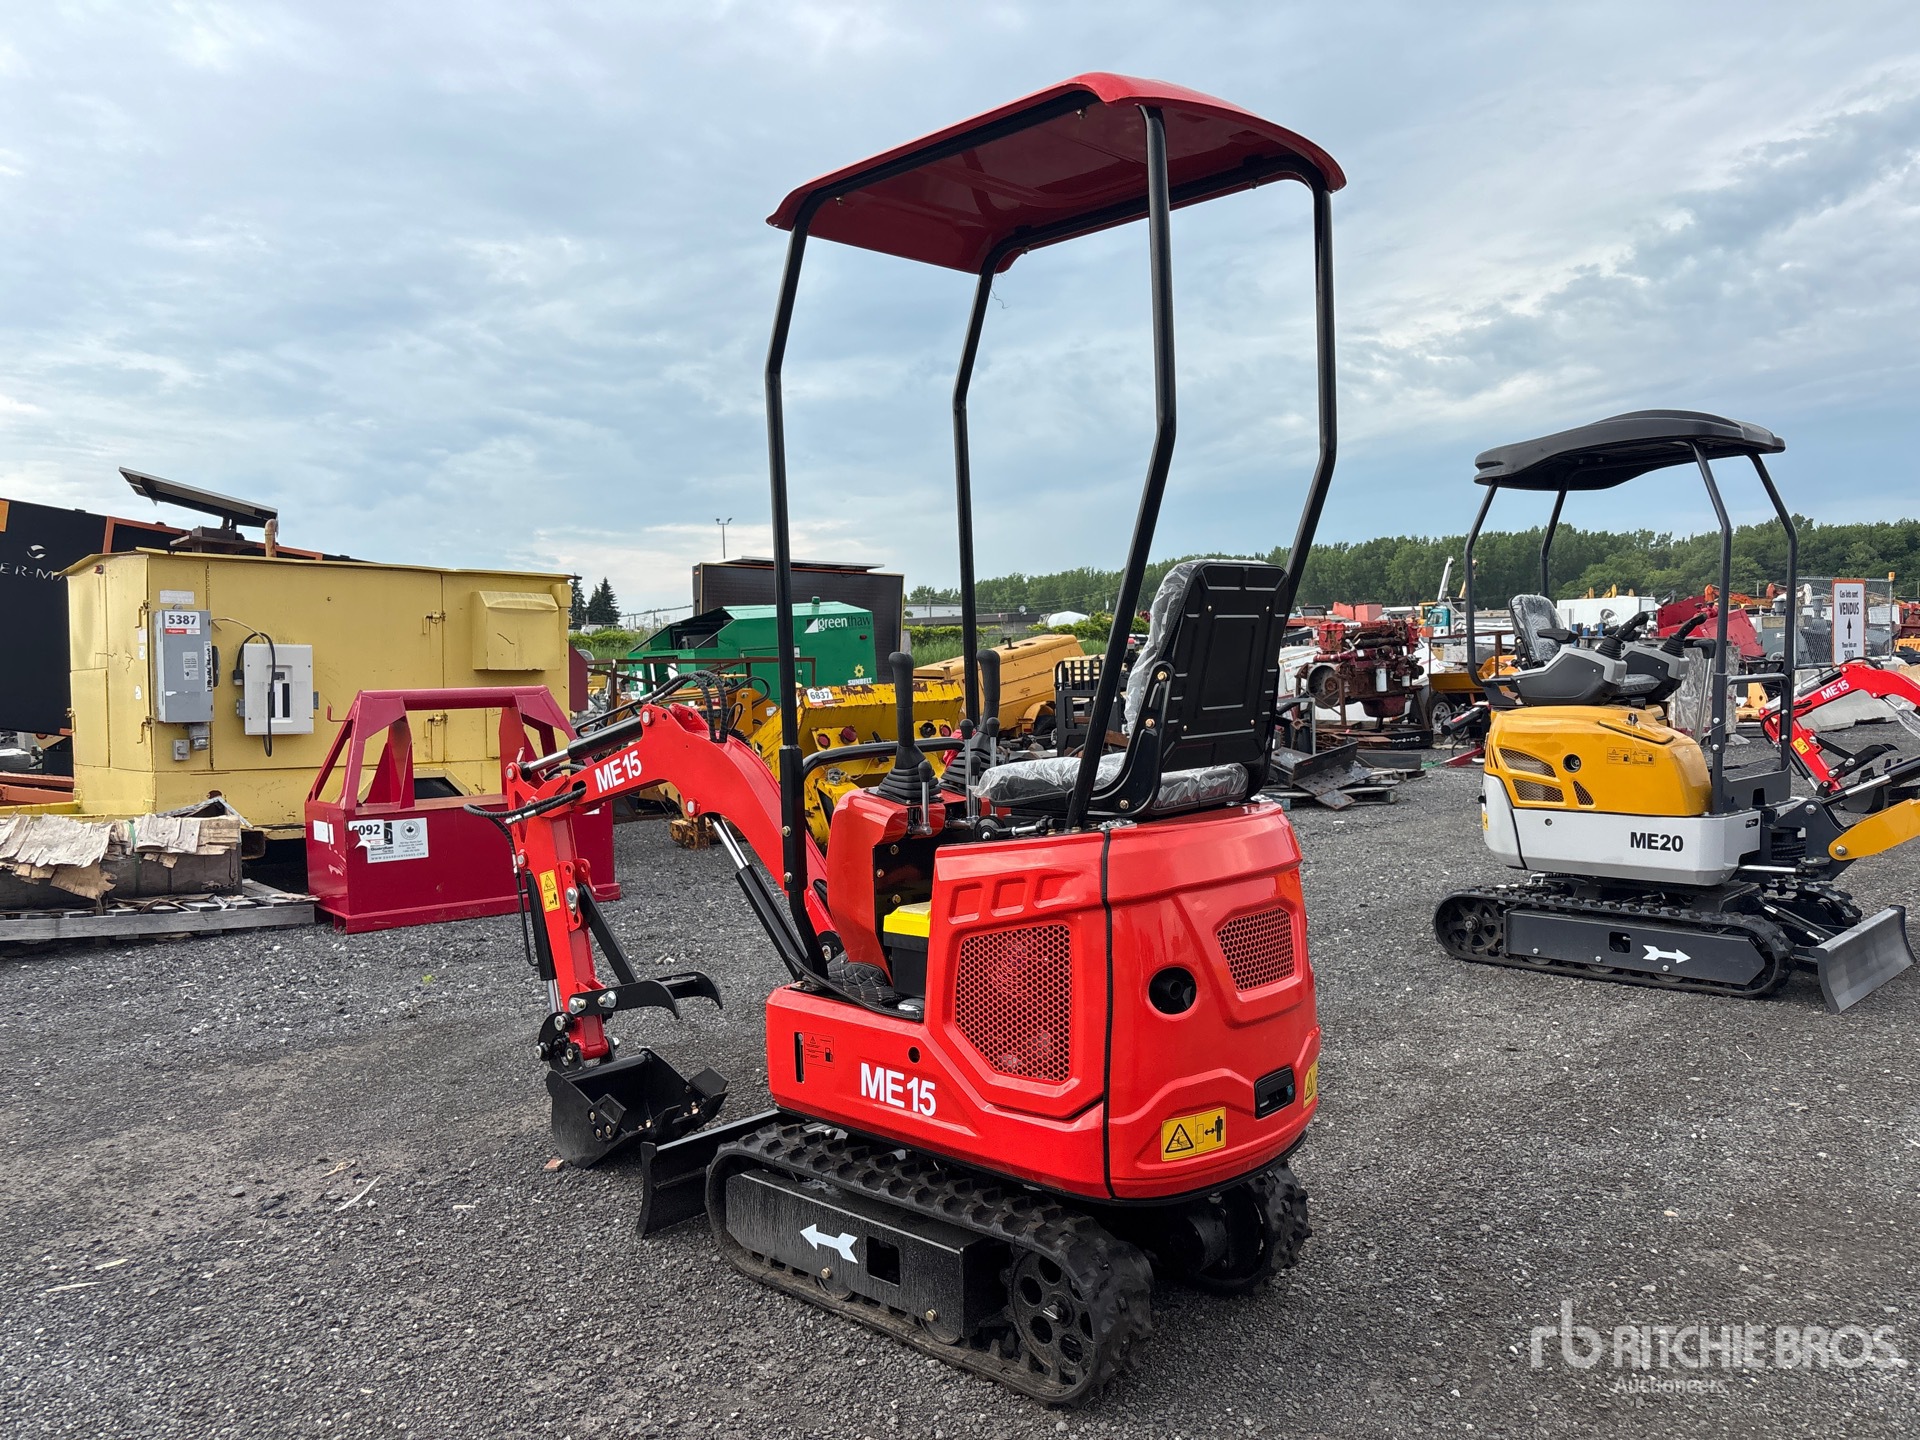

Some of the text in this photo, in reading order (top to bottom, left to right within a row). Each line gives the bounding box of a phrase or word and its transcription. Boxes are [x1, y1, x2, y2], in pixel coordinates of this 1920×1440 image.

[1839, 602, 1860, 615] VENDUS
[167, 614, 197, 625] 5387
[818, 616, 870, 631] greenthaw
[848, 677, 873, 686] SUNBELT
[810, 691, 830, 700] 6837
[1820, 680, 1850, 700] ME15
[594, 750, 643, 794] ME15
[1630, 831, 1684, 853] ME20
[860, 1062, 937, 1117] ME15
